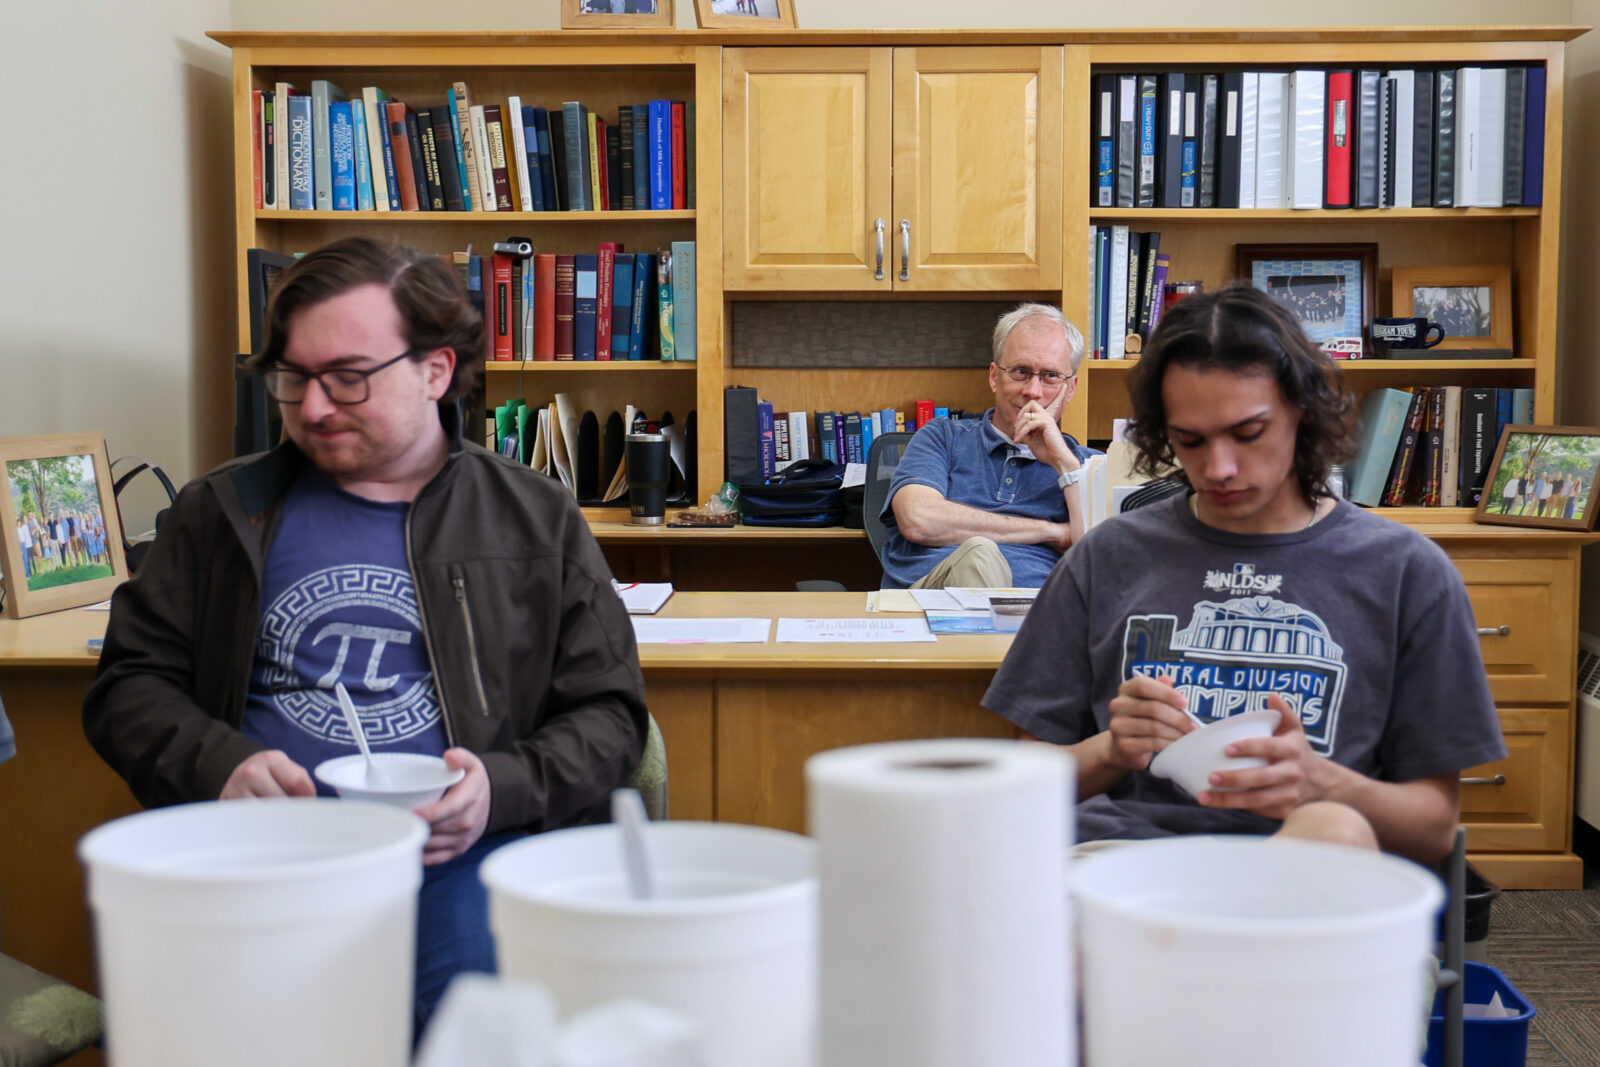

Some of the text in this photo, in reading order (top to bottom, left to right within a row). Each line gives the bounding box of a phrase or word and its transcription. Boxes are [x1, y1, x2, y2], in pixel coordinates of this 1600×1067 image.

[292, 119, 304, 192] DICTIONARY
[423, 144, 433, 181] FOODSTUFFS
[427, 128, 440, 186] EFFECTS OF HEATING
[1397, 325, 1416, 337] YOUNG
[1475, 438, 1483, 448] Food
[1474, 449, 1483, 474] Engineering
[1219, 571, 1267, 590] NLDS
[1229, 588, 1251, 596] 2011
[1233, 668, 1328, 697] DIVISION
